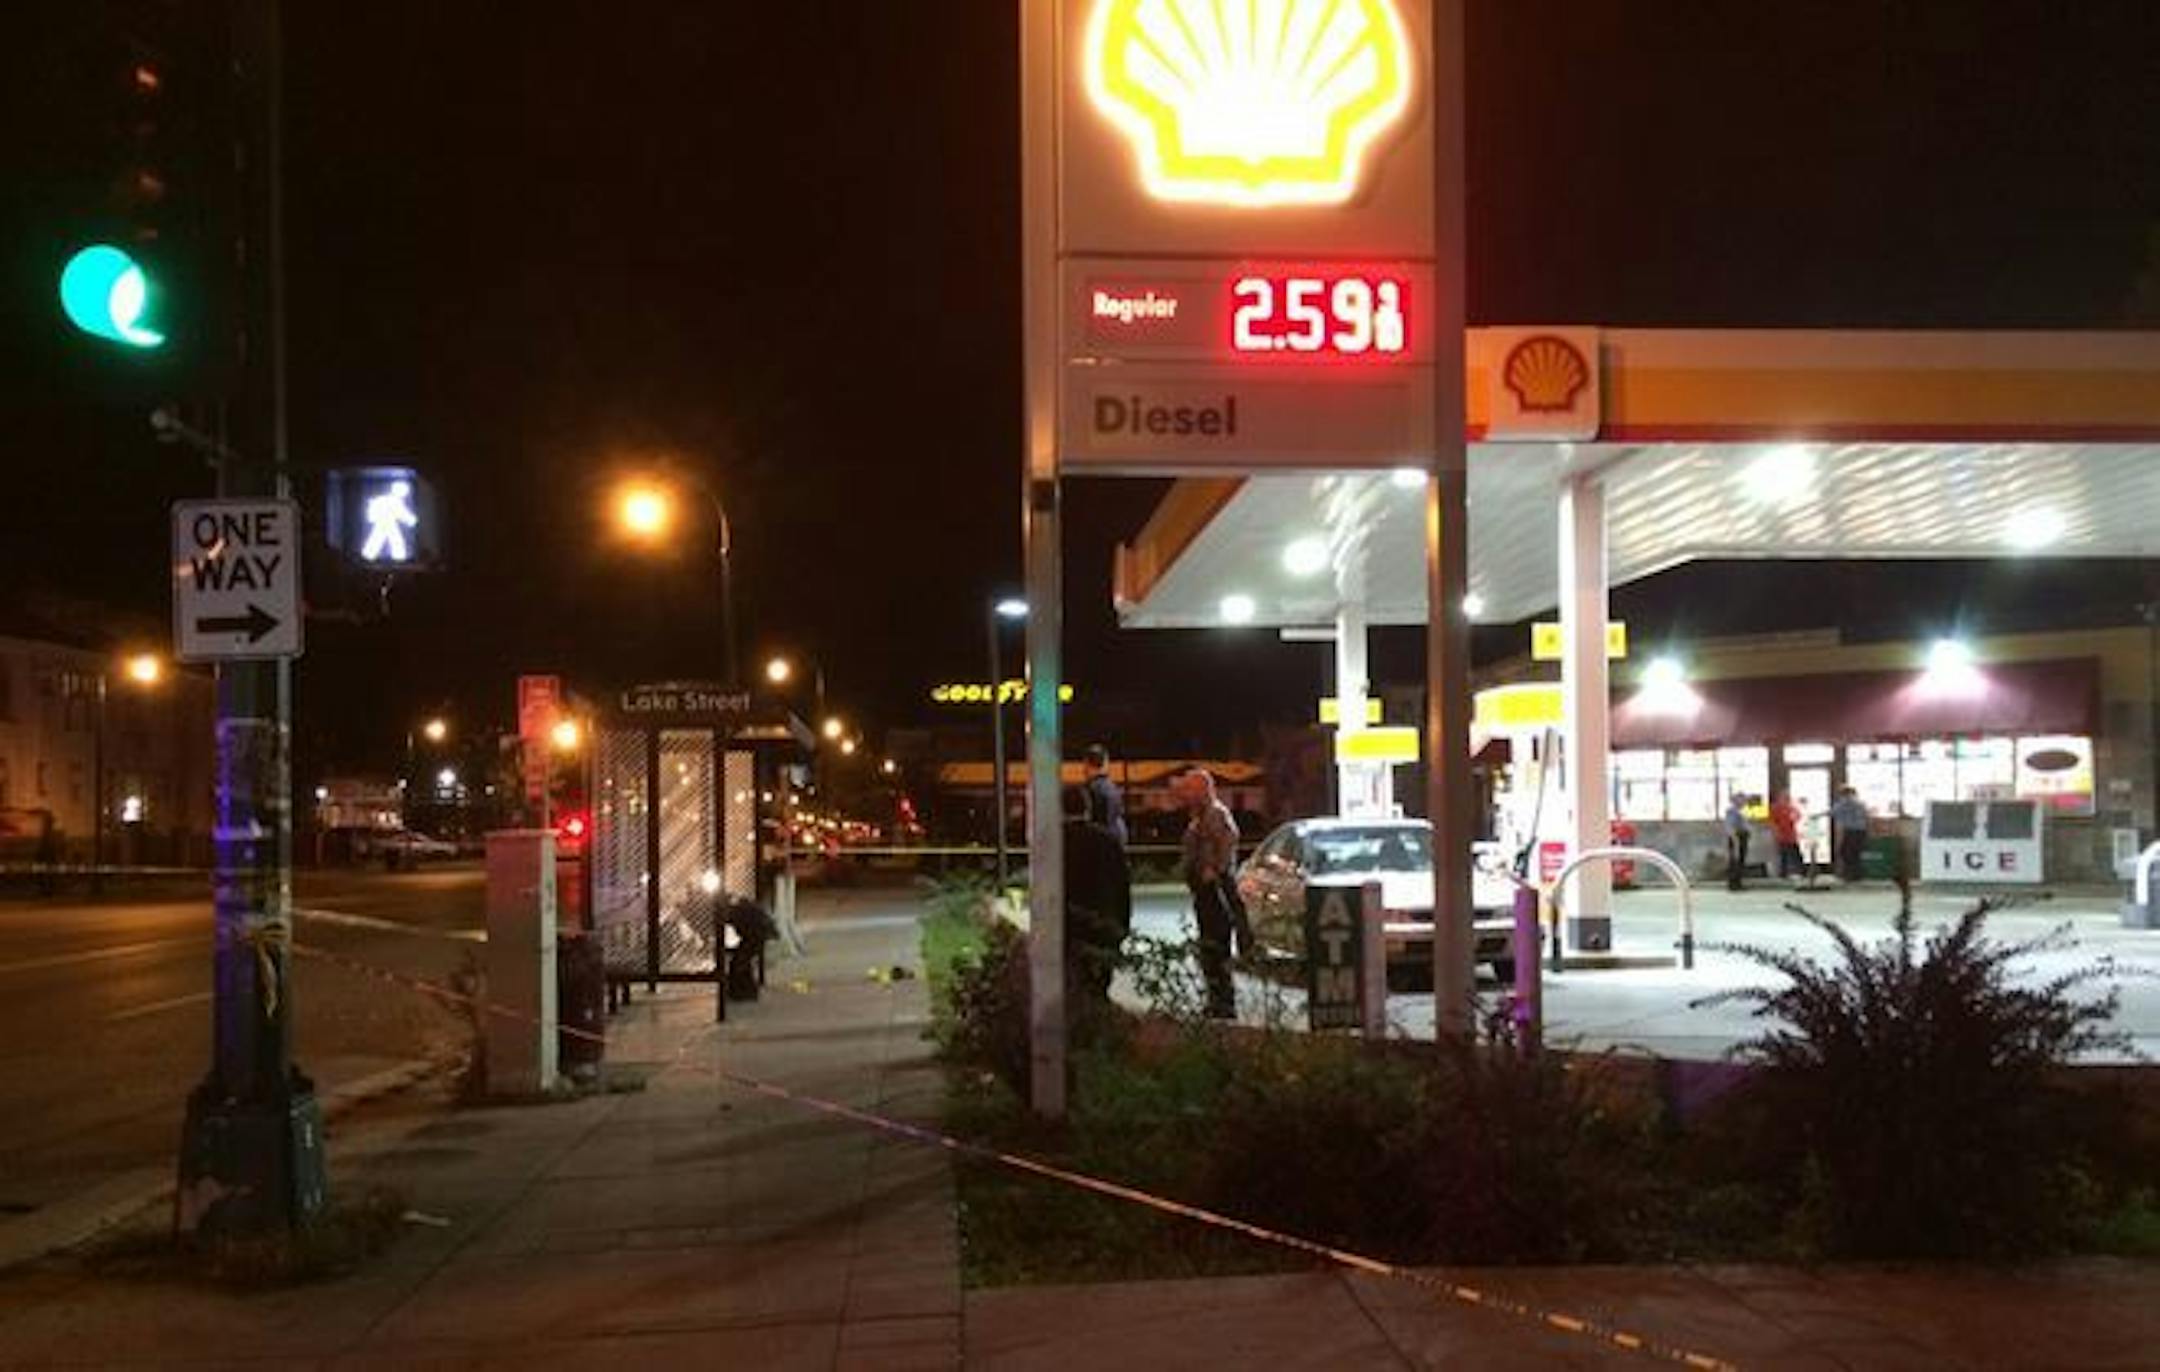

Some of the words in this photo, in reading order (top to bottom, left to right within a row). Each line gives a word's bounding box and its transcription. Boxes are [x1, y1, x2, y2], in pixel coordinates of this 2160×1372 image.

[1093, 291, 1178, 323] Regular
[1094, 395, 1238, 436] Diesel
[193, 513, 280, 547] ONE
[191, 554, 280, 591] WAY
[622, 691, 678, 711] Lake
[684, 690, 750, 711] Street
[1943, 850, 2018, 871] ICE
[1317, 891, 1356, 1003] ATM
